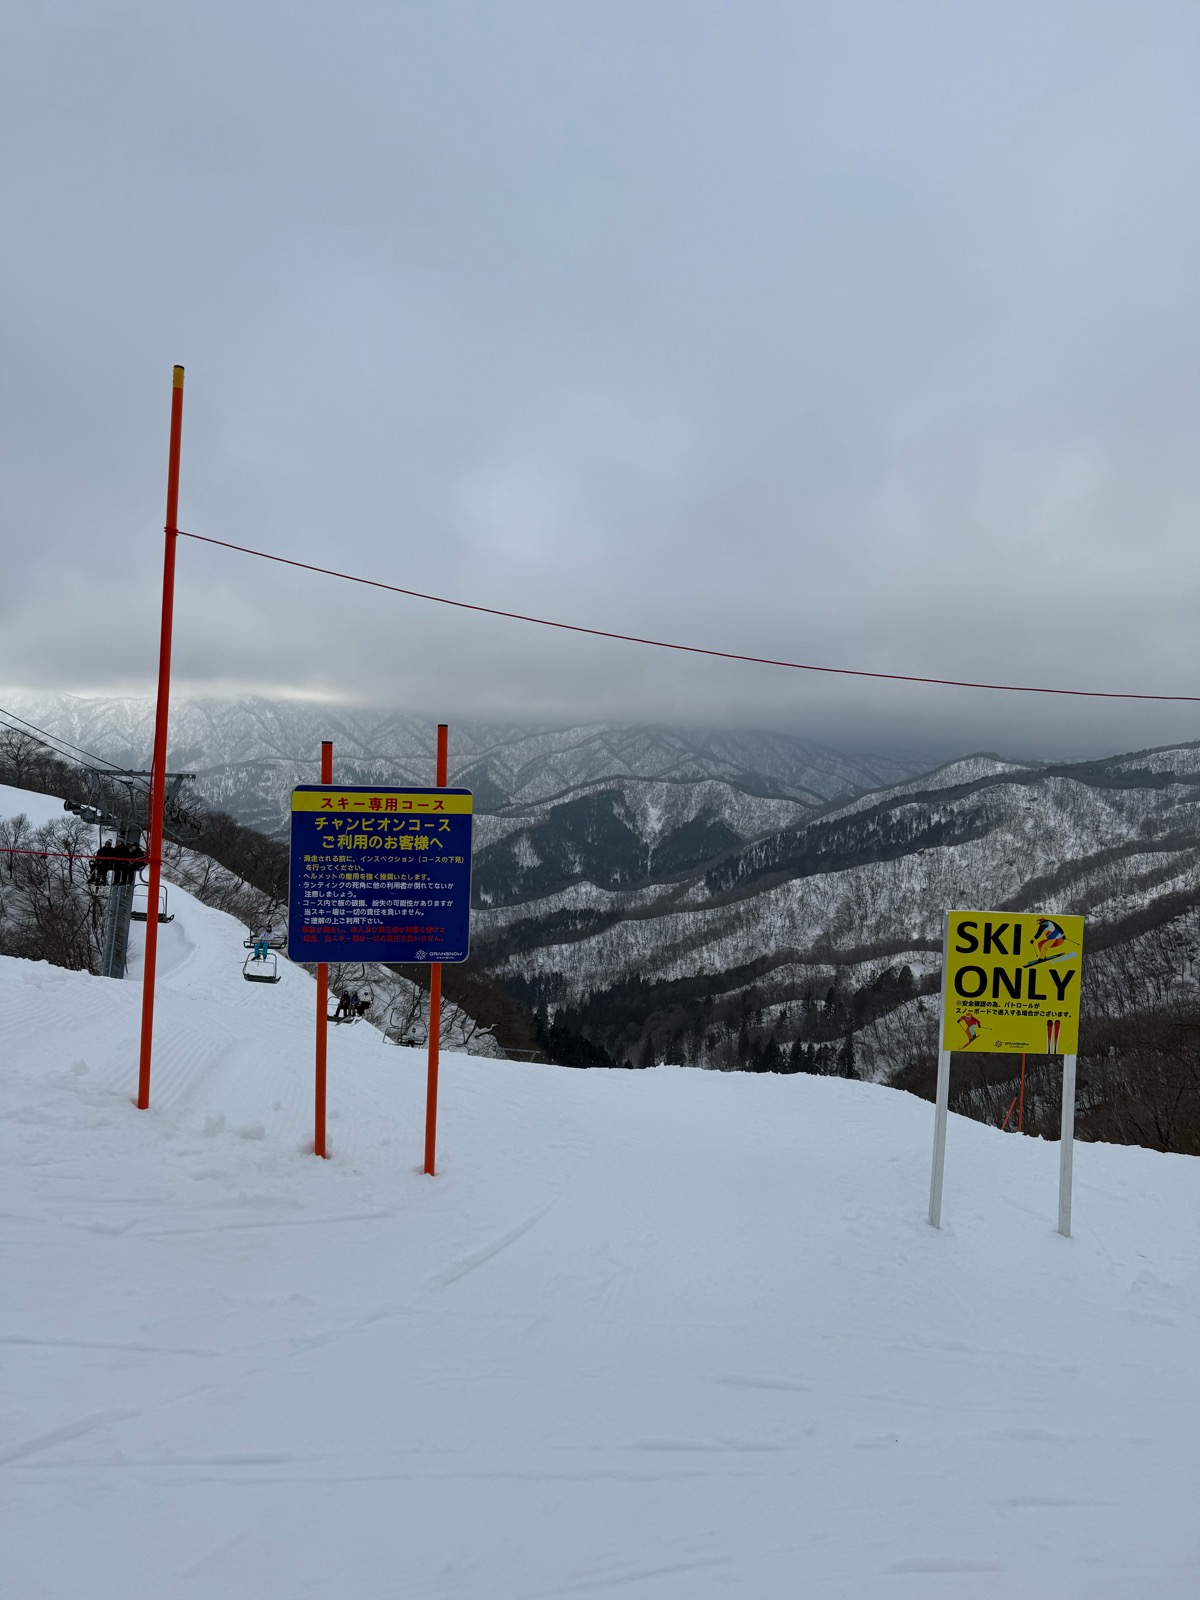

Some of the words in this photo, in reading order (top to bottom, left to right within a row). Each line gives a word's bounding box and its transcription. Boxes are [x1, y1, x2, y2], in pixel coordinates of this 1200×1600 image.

[321, 797, 445, 811] スキー専用コース
[315, 818, 451, 832] チャンピオンコース
[322, 835, 443, 850] ご利用のお客様へ
[955, 921, 1022, 955] SKI
[954, 965, 1075, 1001] ONLY
